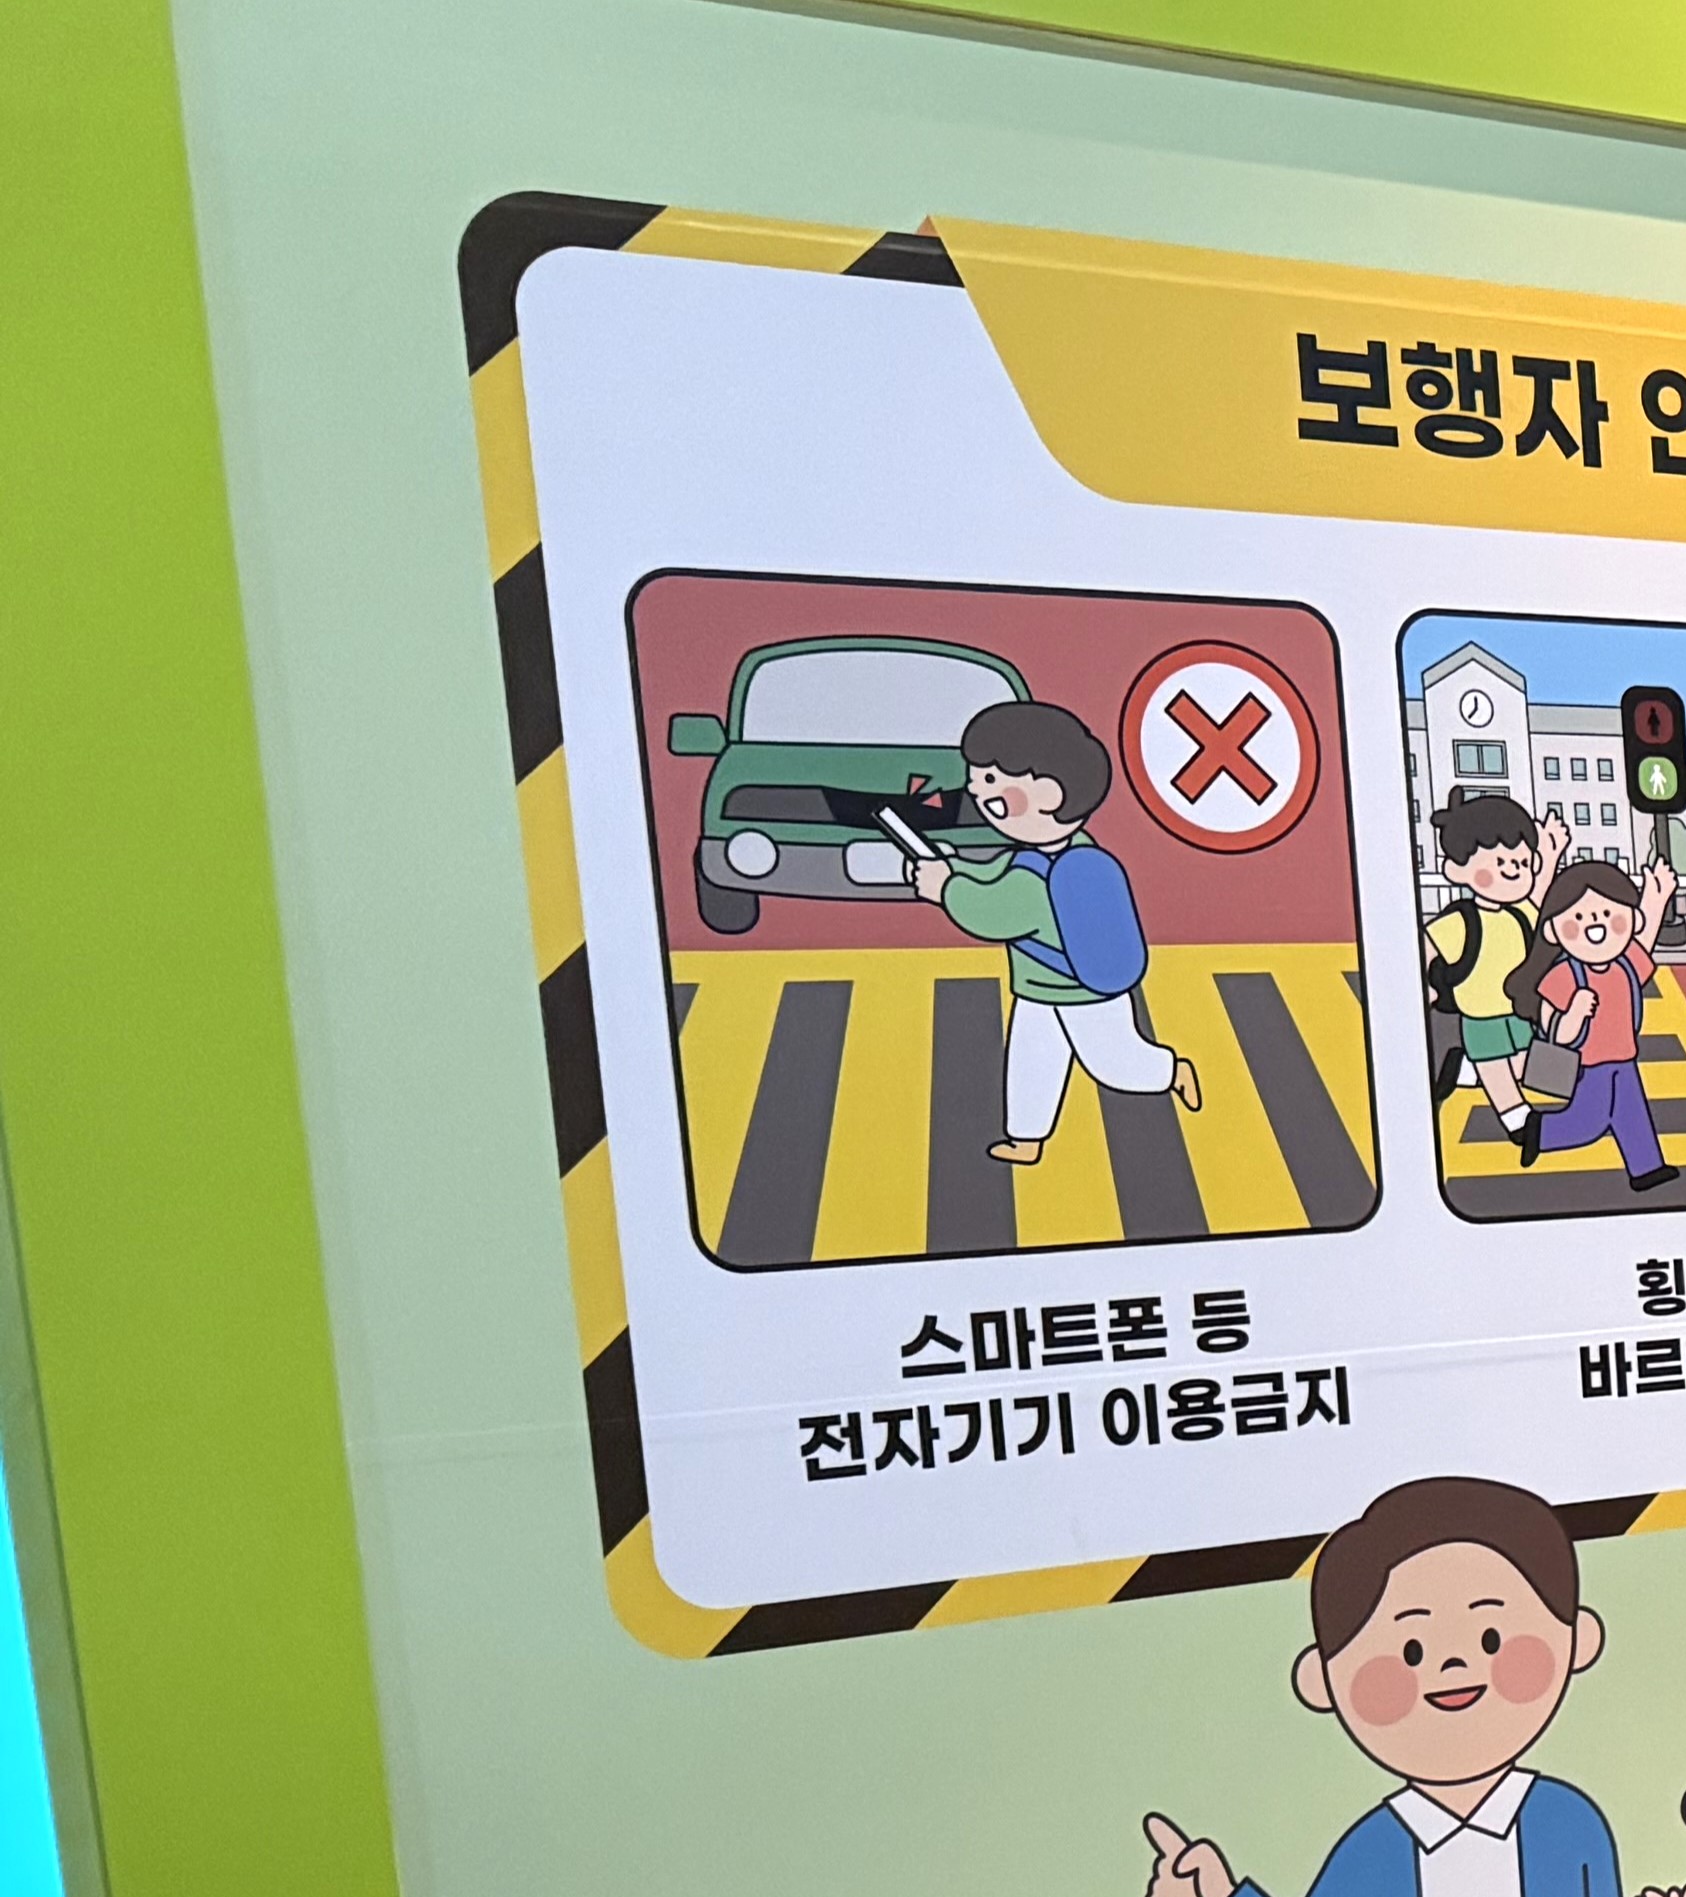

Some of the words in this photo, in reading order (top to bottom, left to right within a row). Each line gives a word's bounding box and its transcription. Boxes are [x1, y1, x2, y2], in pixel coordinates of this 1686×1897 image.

[1296, 331, 1610, 470] 보행자
[900, 1294, 1168, 1379] 스마트폰
[1191, 1289, 1251, 1354] 등
[798, 1391, 1076, 1482] 전자기기
[1101, 1365, 1351, 1447] 이용금지
